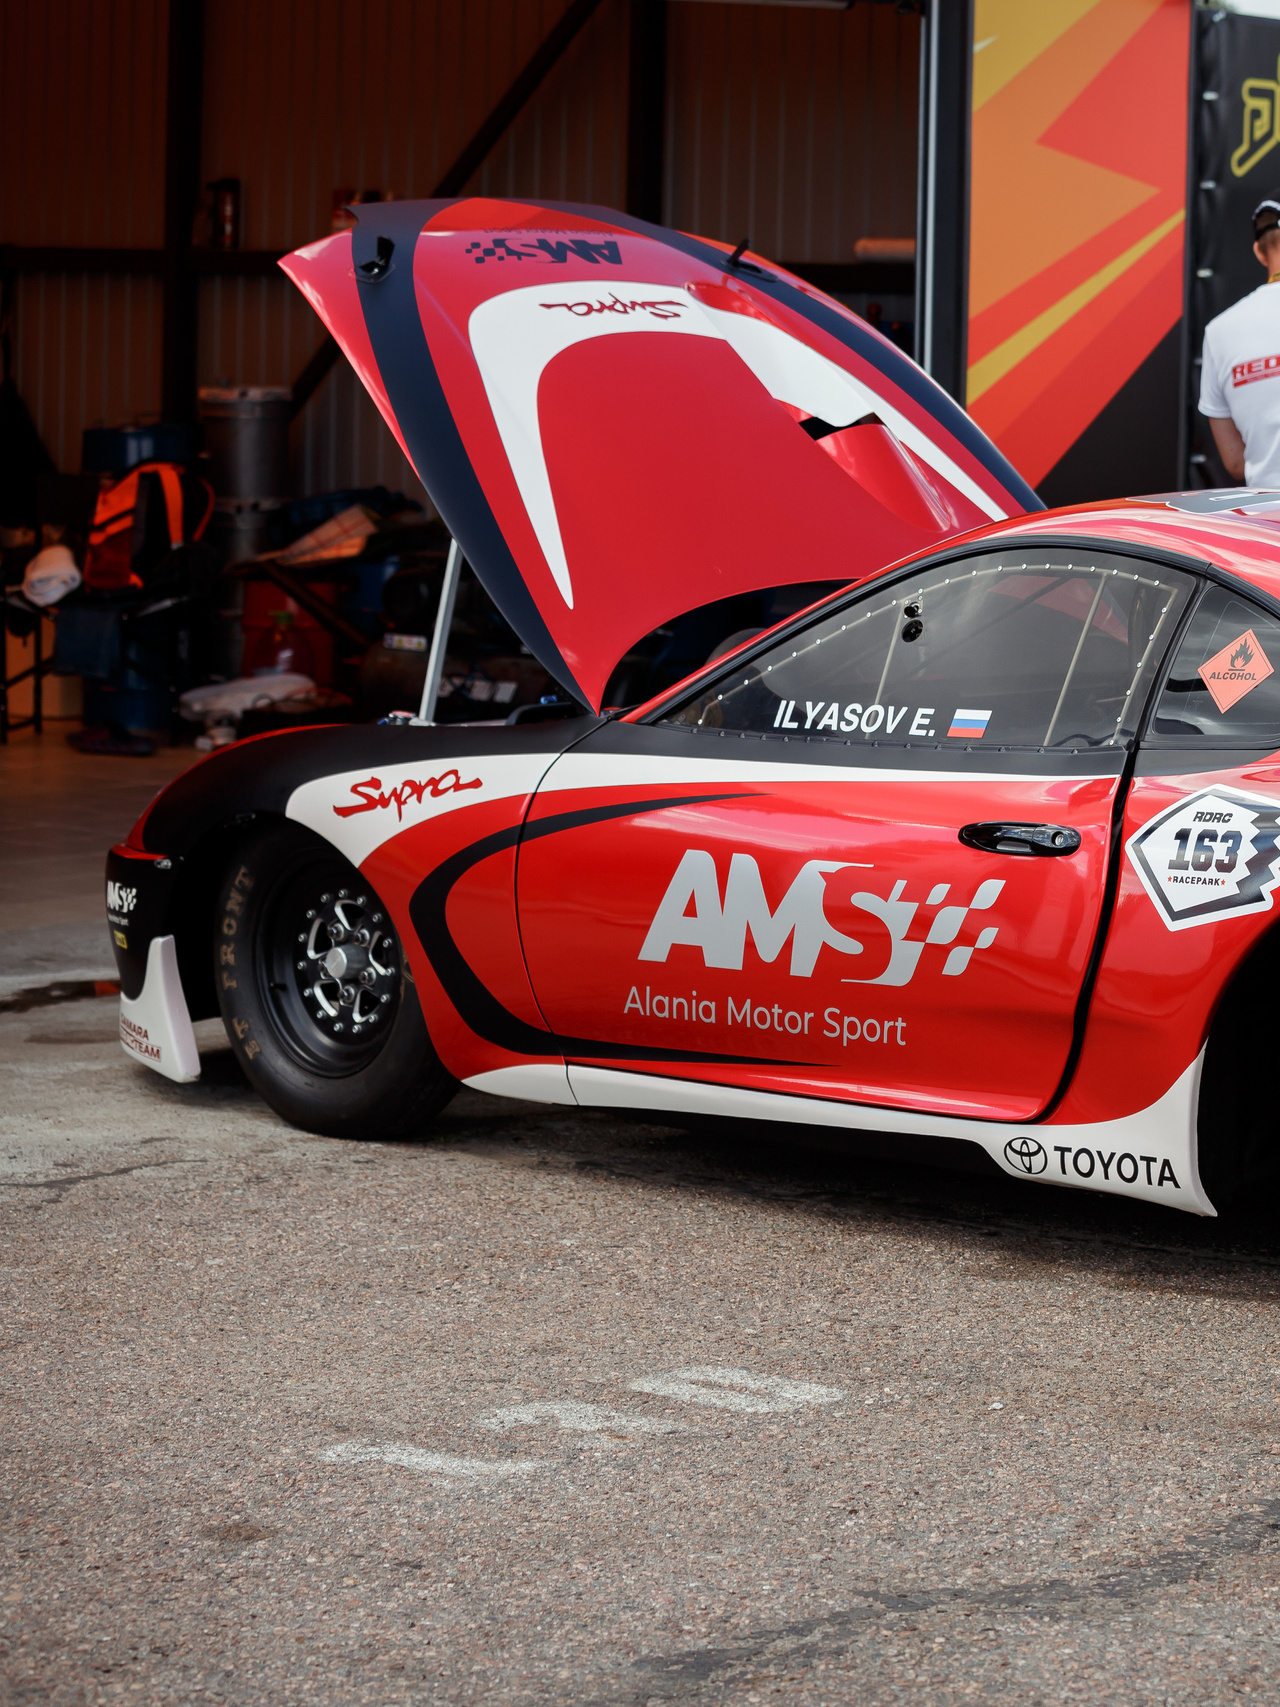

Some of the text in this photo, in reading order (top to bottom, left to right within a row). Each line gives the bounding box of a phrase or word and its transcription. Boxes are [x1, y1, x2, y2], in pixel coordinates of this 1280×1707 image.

[539, 292, 689, 321] Supra
[1208, 671, 1257, 682] ALCOHOL
[773, 700, 935, 737] ILYASOV E.
[333, 769, 483, 822] Supra
[1193, 811, 1233, 823] RDRC
[1167, 828, 1243, 873] 163
[1172, 876, 1221, 887] RACEPARK
[219, 865, 252, 991] FRONT
[623, 986, 907, 1047] Alania Motor Sport
[1053, 1145, 1182, 1190] TOYOTA
